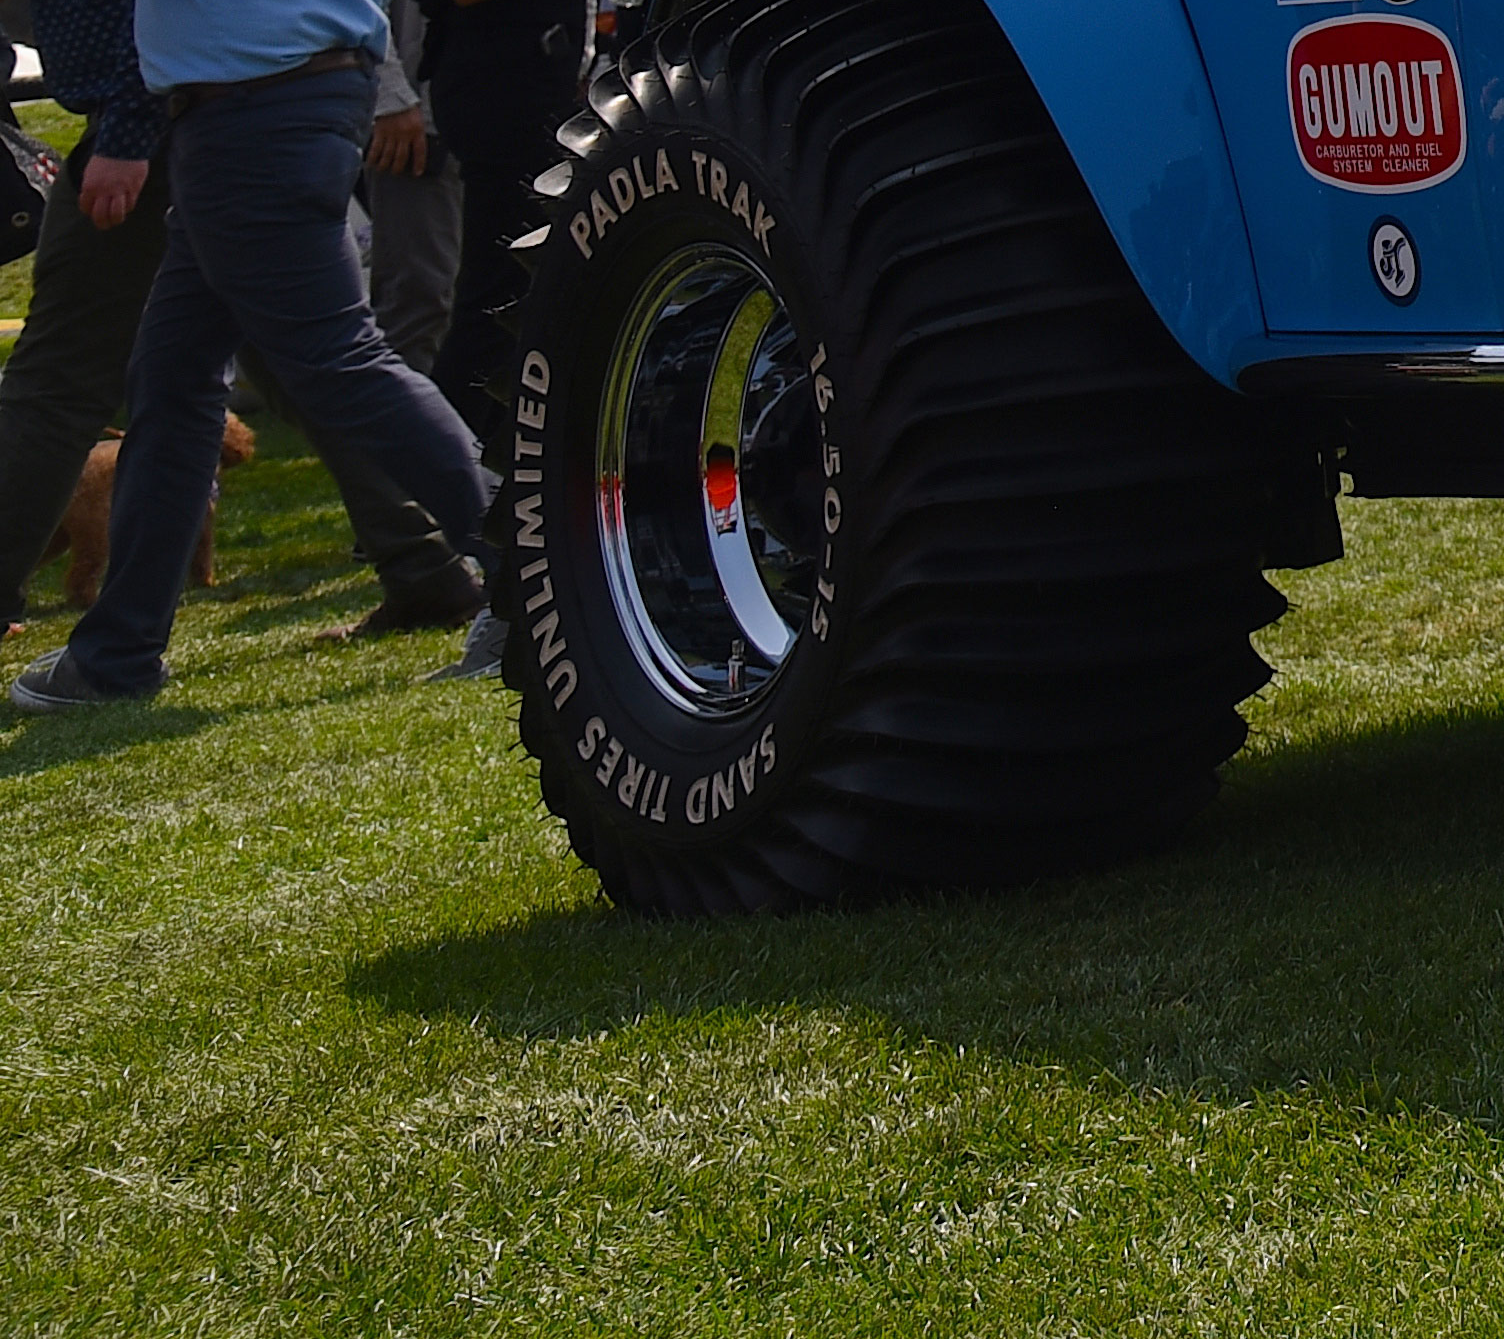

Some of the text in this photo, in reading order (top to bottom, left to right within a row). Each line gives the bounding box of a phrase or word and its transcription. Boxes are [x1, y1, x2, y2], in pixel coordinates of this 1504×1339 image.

[1298, 59, 1444, 140] GUMOUT
[1315, 142, 1443, 160] CARBURETOR AND FUEL
[1333, 158, 1430, 174] SYSTEM CLEANER
[569, 147, 776, 261] PADLA TRAK
[513, 349, 777, 824] SAND TIRES UNLIMITED
